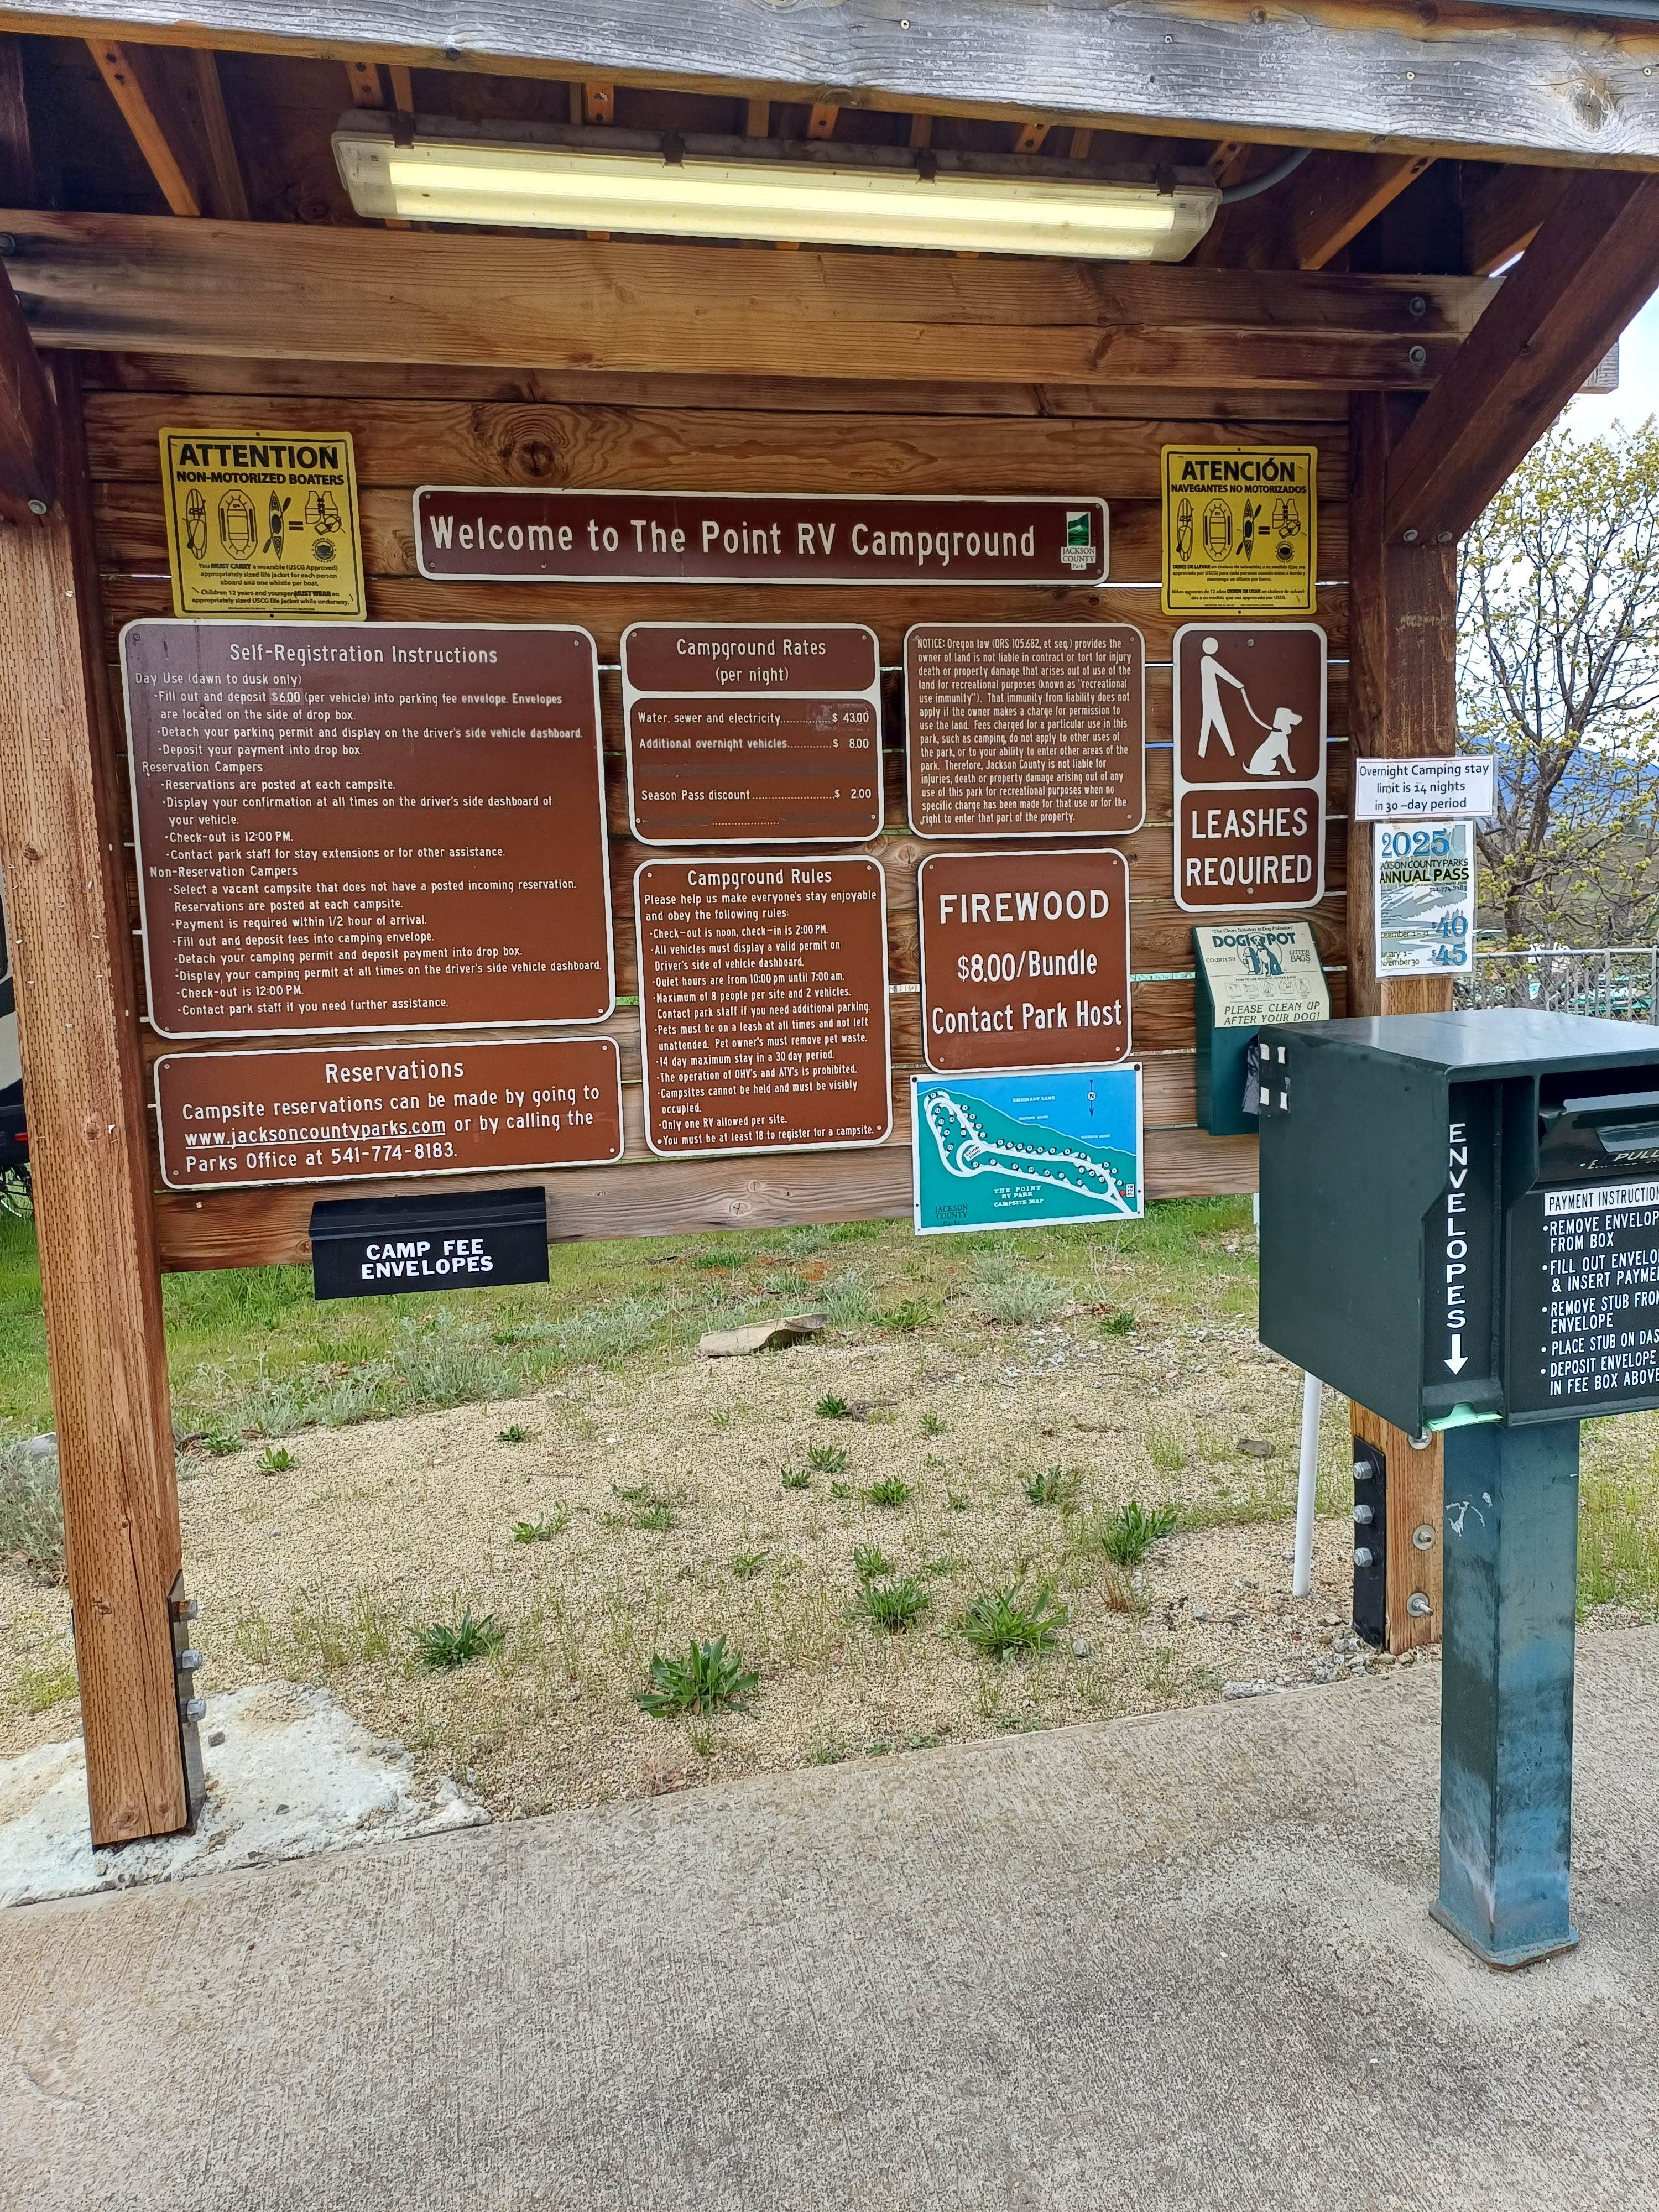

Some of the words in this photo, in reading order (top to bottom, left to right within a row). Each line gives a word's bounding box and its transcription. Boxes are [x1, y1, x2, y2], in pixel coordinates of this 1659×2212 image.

[179, 443, 339, 469] ATTENTION
[176, 471, 286, 484] NON-MOTORIZED
[289, 473, 345, 486] BOATERS
[1181, 457, 1295, 482] ATENCIÓN
[1171, 484, 1228, 493] NAVEGANTES
[1229, 484, 1243, 493] NO
[1244, 484, 1306, 494] MOTORIZADOS
[429, 515, 573, 551] Welcome
[587, 519, 619, 552] to
[630, 520, 686, 553] The
[702, 520, 781, 555] Point
[797, 523, 836, 555] RV
[852, 524, 1034, 566] Campground
[677, 639, 775, 660] Campground
[783, 639, 826, 655] Rates
[917, 638, 946, 649] NOTICE:
[947, 638, 974, 651] Oregon
[977, 638, 990, 649] law
[992, 638, 1009, 649] (ORS
[1044, 638, 1052, 649] et
[1074, 638, 1107, 651] provides
[1109, 638, 1121, 649] the
[229, 644, 384, 666] Self-Registration
[392, 645, 498, 664] Instructions
[135, 672, 157, 686] Day
[163, 672, 184, 684] Use
[187, 672, 221, 684] (dawn
[226, 673, 238, 684] to
[242, 673, 268, 685] dusk
[273, 674, 302, 688] only)
[716, 667, 743, 686] (per
[749, 666, 789, 686] night)
[674, 714, 702, 723] sewer
[706, 713, 724, 723] and
[142, 761, 210, 773] Reservation
[215, 761, 263, 775] Campers
[1359, 765, 1408, 779] Overnight
[1411, 764, 1461, 777] Camping
[1464, 764, 1489, 775] stay
[641, 790, 677, 801] Season
[681, 790, 705, 800] Pass
[851, 788, 872, 799] 2.00
[1377, 782, 1400, 794] limit
[1402, 781, 1411, 793] is
[1413, 784, 1427, 795] 14
[1430, 780, 1465, 795] nights
[1375, 800, 1383, 811] in
[1386, 802, 1398, 813] 30
[1431, 797, 1467, 812] period
[923, 814, 941, 827] right
[943, 813, 952, 823] to
[954, 813, 975, 823] enter
[978, 812, 994, 823] that
[997, 812, 1013, 825] part
[1015, 811, 1022, 822] of
[1025, 812, 1038, 822] the
[1040, 811, 1076, 824] property.
[1192, 807, 1308, 839] LEASHES
[169, 831, 226, 843] Check-out
[231, 831, 241, 842] is
[244, 831, 273, 842] 12:00
[275, 831, 293, 842] PM.
[1381, 828, 1449, 858] 2025
[150, 865, 245, 878] Non-Reservation
[250, 865, 298, 879] Campers
[1186, 854, 1312, 887] REQUIRED
[1408, 859, 1442, 869] COUNTY
[1443, 858, 1469, 867] PARKS
[687, 868, 784, 890] Campground
[791, 868, 832, 884] Rules
[1380, 869, 1431, 884] ANNUAL
[1434, 868, 1469, 881] PASS
[940, 889, 1109, 924] FIREWOOD
[175, 919, 225, 932] Payment
[229, 918, 238, 928] is
[243, 917, 288, 931] required
[291, 916, 325, 927] within
[328, 916, 344, 926] 1/2
[348, 916, 372, 926] hour
[376, 915, 386, 925] of
[390, 914, 427, 925] arrival.
[958, 948, 1097, 982] $8.00/Bundle
[1291, 954, 1311, 962] BAGS
[932, 1004, 1014, 1034] Contact
[1022, 1001, 1068, 1030] Park
[1077, 999, 1122, 1027] Host
[1224, 1004, 1264, 1015] PLEASE
[1269, 1002, 1302, 1013] CLEAN
[1307, 1001, 1321, 1010] UP
[1224, 1016, 1256, 1025] AFTER
[1261, 1014, 1289, 1023] YOUR
[1293, 1011, 1320, 1021] DOG!
[325, 1059, 464, 1083] Reservations
[185, 1119, 446, 1149] www.jacksoncountyparks.com
[454, 1119, 472, 1131] or
[479, 1114, 499, 1134] by
[506, 1112, 560, 1131] calling
[567, 1110, 593, 1125] the
[662, 1119, 681, 1132] Only
[685, 1120, 700, 1129] one
[703, 1117, 714, 1128] RV
[716, 1115, 748, 1127] allowed
[752, 1117, 765, 1128] per
[768, 1113, 787, 1124] site.
[186, 1155, 237, 1172] Parks
[246, 1151, 297, 1169] Office
[306, 1149, 323, 1166] at
[331, 1141, 457, 1164] 541-774-8183.
[1549, 1192, 1594, 1212] PAYMENT
[1446, 1123, 1468, 1329] ENVELOPES
[1550, 1217, 1600, 1236] REMOVE
[367, 1241, 431, 1261] CAMP
[443, 1238, 484, 1255] FEE
[1550, 1232, 1584, 1253] FROM
[1590, 1230, 1614, 1249] BOX
[361, 1256, 493, 1280] ENVELOPES
[1551, 1312, 1614, 1334] ENVELOPE
[1550, 1357, 1597, 1378] DEPOSIT
[1601, 1349, 1656, 1371] ENVELOPE
[1550, 1380, 1562, 1396] IN
[1567, 1376, 1589, 1394] FEE
[1594, 1373, 1618, 1390] BOX
